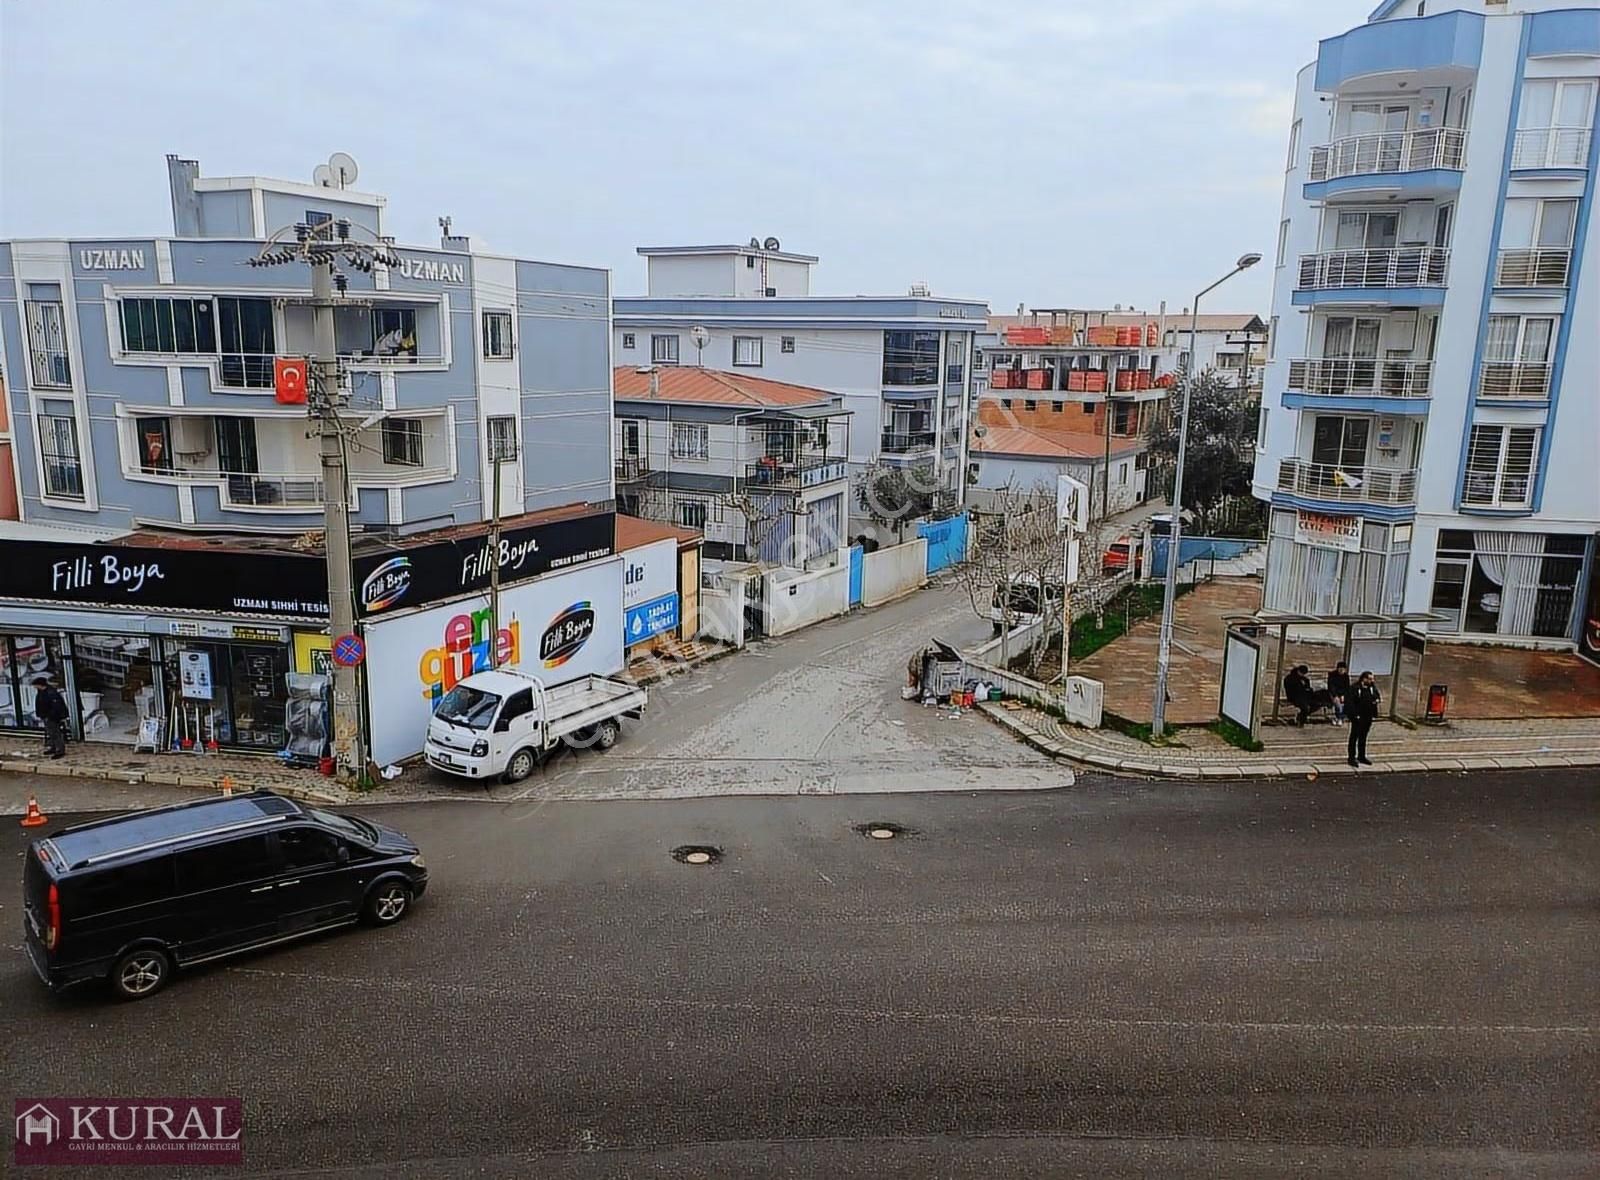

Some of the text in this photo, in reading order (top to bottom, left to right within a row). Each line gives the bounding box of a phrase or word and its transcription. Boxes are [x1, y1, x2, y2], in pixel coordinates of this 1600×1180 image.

[80, 248, 146, 271] UZMAN
[400, 257, 465, 283] UZMAN
[52, 555, 165, 592] Filli Boya
[461, 534, 539, 585] Filli Boya
[625, 564, 644, 585] de
[367, 569, 411, 603] Filli Boya
[233, 597, 269, 610] UZMAN
[300, 600, 330, 614] TESİS
[444, 607, 492, 652] en
[544, 617, 592, 656] Filli Boya
